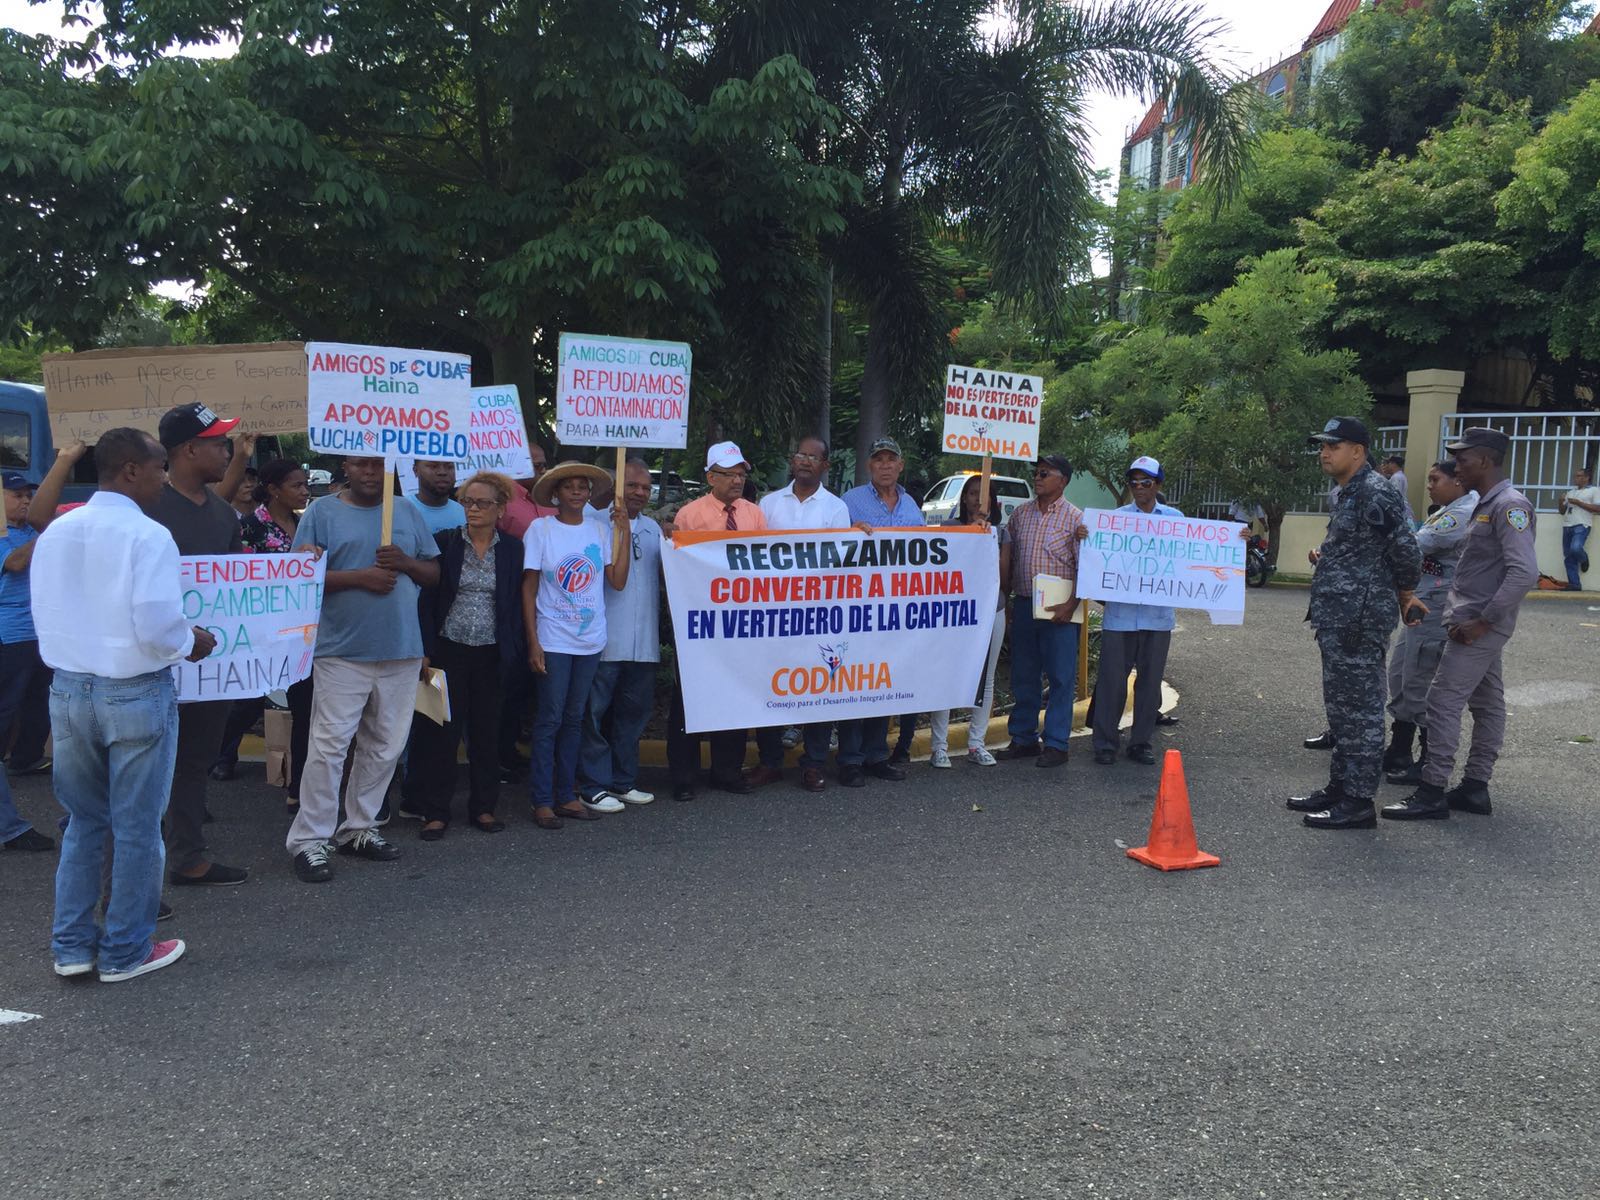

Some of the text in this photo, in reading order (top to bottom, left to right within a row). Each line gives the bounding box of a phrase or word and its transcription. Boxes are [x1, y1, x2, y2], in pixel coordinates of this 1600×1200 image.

[312, 353, 464, 379] AMIGOS DE CUBA
[568, 345, 625, 364] AMIGOS
[649, 351, 685, 367] CUBA
[137, 363, 216, 382] MERECE
[573, 369, 684, 396] REPUDIAMOS
[952, 369, 1033, 392] HAINA
[145, 385, 197, 409] NO
[364, 376, 419, 394] Haina
[947, 385, 1038, 408] NO ES VERTEDERO
[478, 394, 514, 408] CUBA
[946, 401, 1035, 425] DE LA CAPITAL
[324, 403, 450, 431] APOYAMOS
[470, 409, 516, 427] AMOS
[311, 427, 363, 450] LUCHA
[382, 429, 467, 458] PUEBLO
[470, 427, 522, 451] NACIÓN
[566, 423, 649, 438] PARA HAINA
[946, 434, 1032, 457] CODINHA
[1098, 513, 1230, 544] DEFENDEMOS
[726, 538, 948, 570] RECHAZAMOS
[1102, 552, 1176, 576] Y VIDA
[710, 570, 964, 603] CONVERTIR A HAINA
[1102, 572, 1130, 591] EN
[688, 599, 977, 639] EN VERTEDERO DE LA CAPITAL
[771, 662, 892, 696] CODINHA
[766, 700, 796, 709] Consejo
[797, 701, 813, 709] para
[823, 696, 857, 706] Desarrollo
[859, 694, 885, 704] Integral
[886, 693, 895, 701] de
[896, 692, 914, 700] Haina
